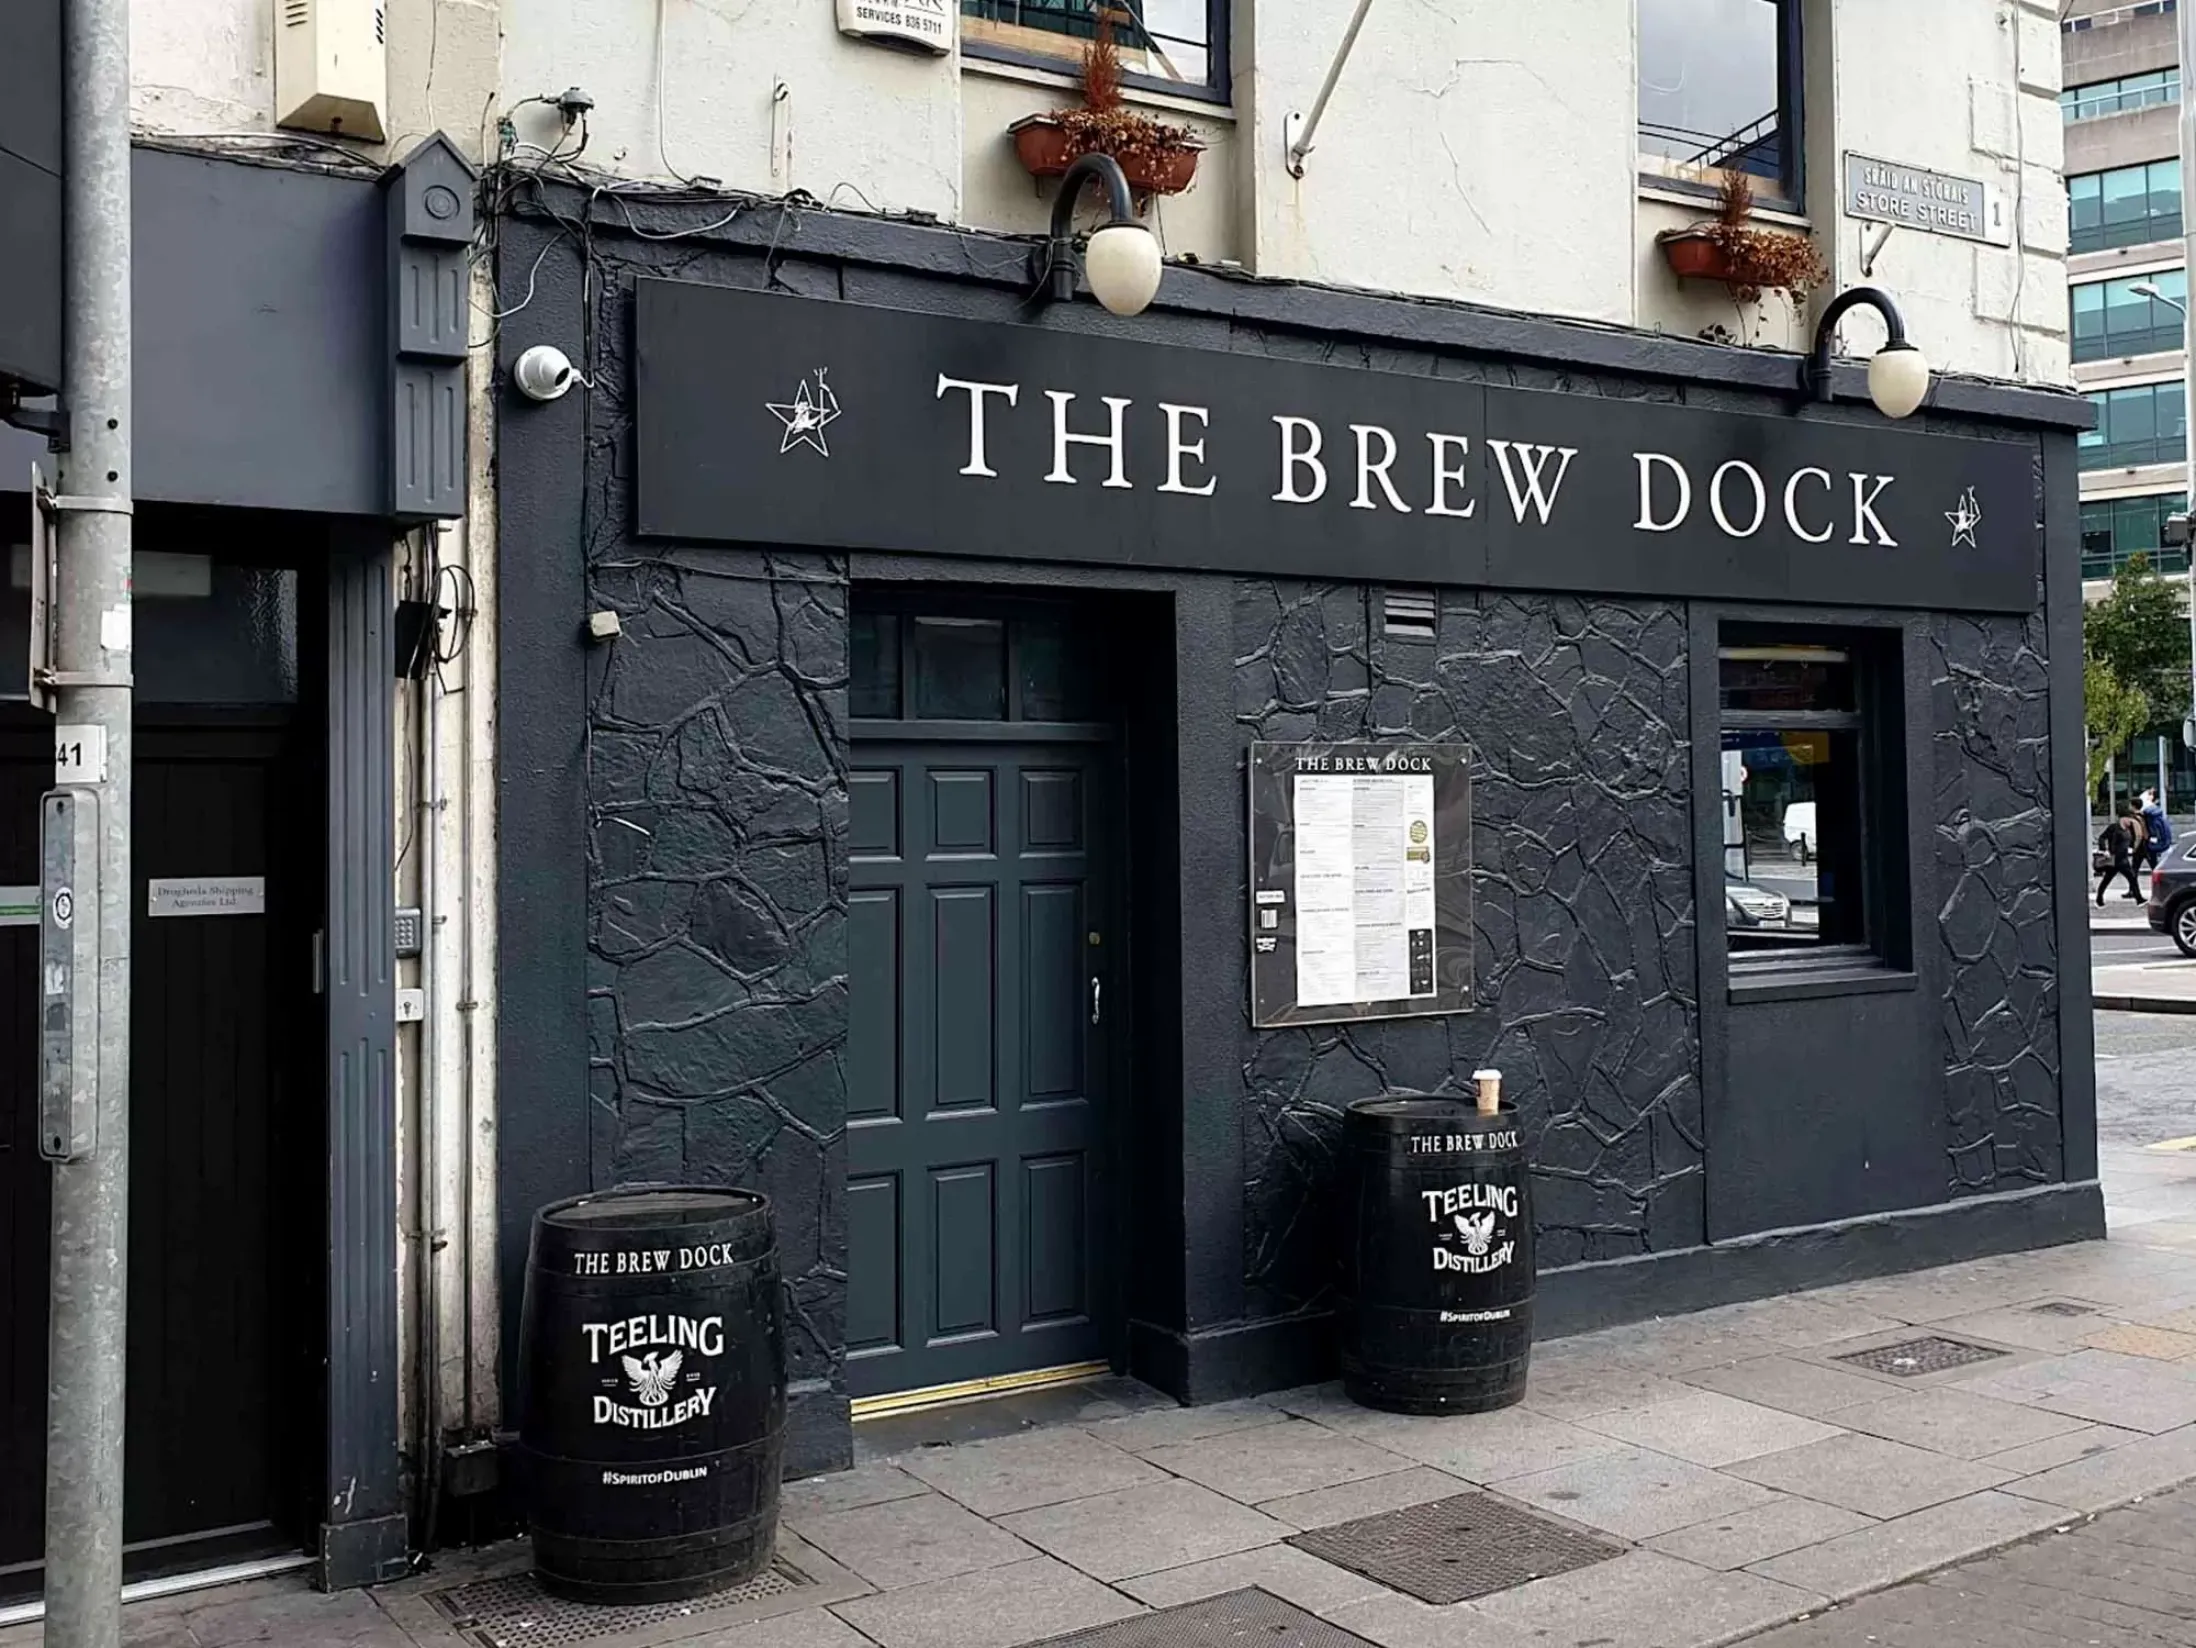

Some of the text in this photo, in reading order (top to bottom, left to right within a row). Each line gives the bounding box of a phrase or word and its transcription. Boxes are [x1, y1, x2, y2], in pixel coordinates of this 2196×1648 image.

[856, 7, 901, 25] SERVICES
[923, 19, 942, 34] 5711
[1902, 176, 1918, 194] AN
[1857, 191, 1976, 231] STORE STREET
[936, 372, 1898, 547] THE BREW DOCK
[1295, 757, 1432, 771] THE BREW DOCK
[1411, 1130, 1519, 1153] THE BREW DOCK
[1422, 1183, 1518, 1223] TEELING
[574, 1243, 734, 1275] THE BREW DOCK
[1433, 1240, 1515, 1273] DISTILLERY
[582, 1314, 724, 1363] TEELING
[593, 1386, 717, 1429] DISTILLERY
